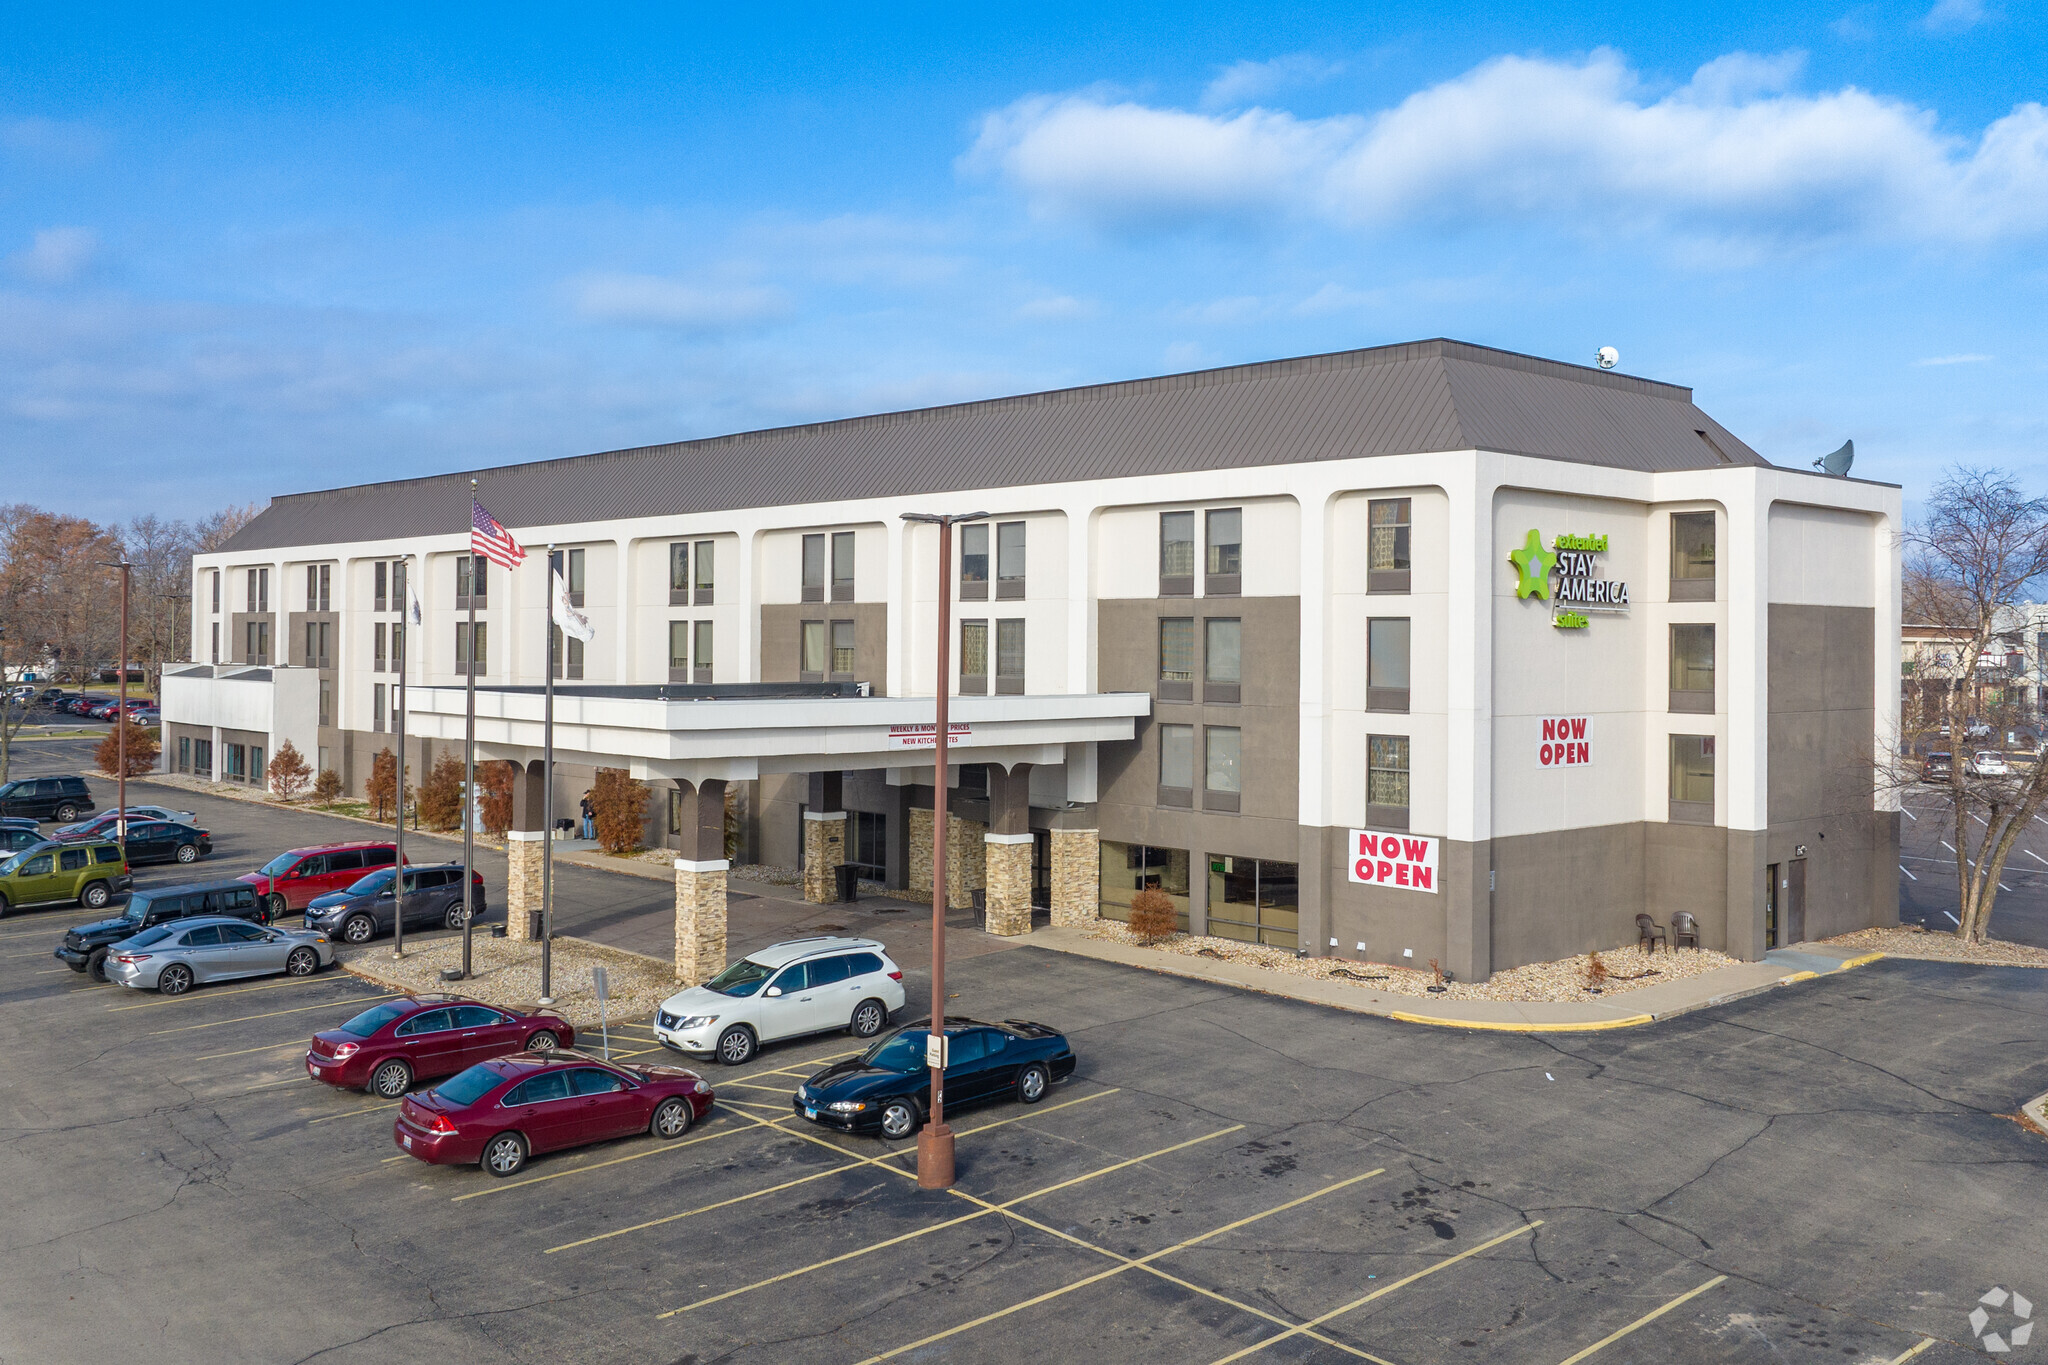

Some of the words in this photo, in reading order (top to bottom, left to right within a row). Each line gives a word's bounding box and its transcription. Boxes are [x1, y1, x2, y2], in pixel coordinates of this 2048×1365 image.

[1557, 533, 1608, 551] extended
[1559, 552, 1596, 576] STAY
[1559, 578, 1629, 604] AMERICA
[1558, 611, 1589, 628] suites
[1543, 718, 1587, 741] NOW
[1540, 742, 1588, 765] OPEN
[1360, 834, 1428, 862] NOW
[1355, 858, 1431, 889] OPEN
